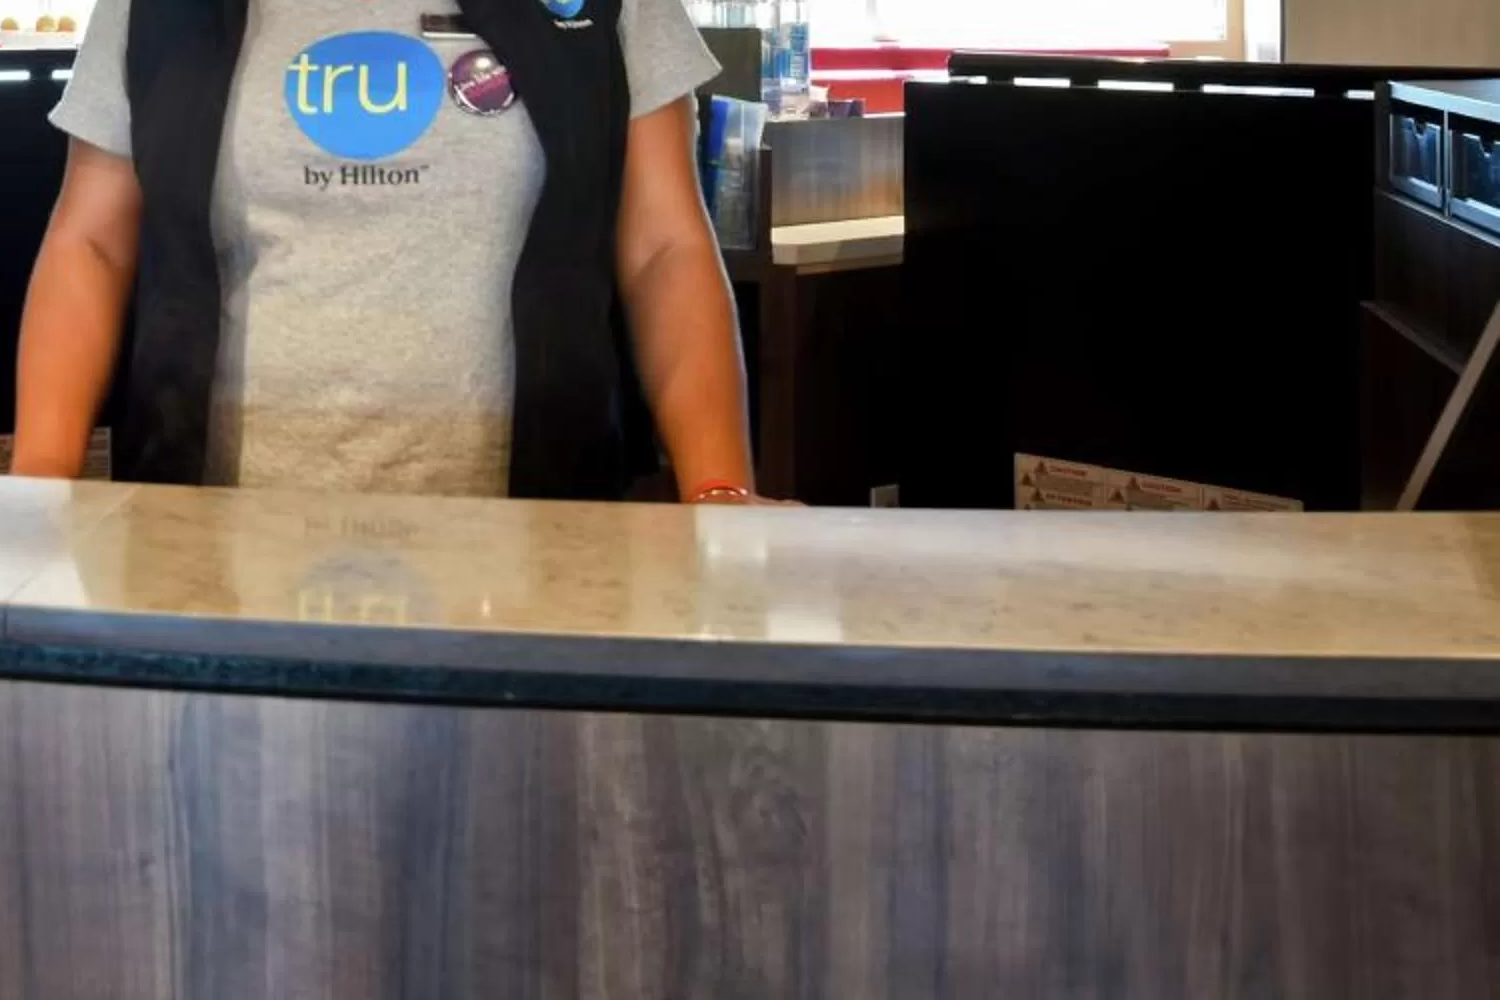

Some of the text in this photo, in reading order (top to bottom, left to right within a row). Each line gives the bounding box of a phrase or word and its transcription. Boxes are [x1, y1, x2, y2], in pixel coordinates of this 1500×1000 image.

[287, 53, 409, 114] tru
[304, 164, 420, 191] by Hilton
